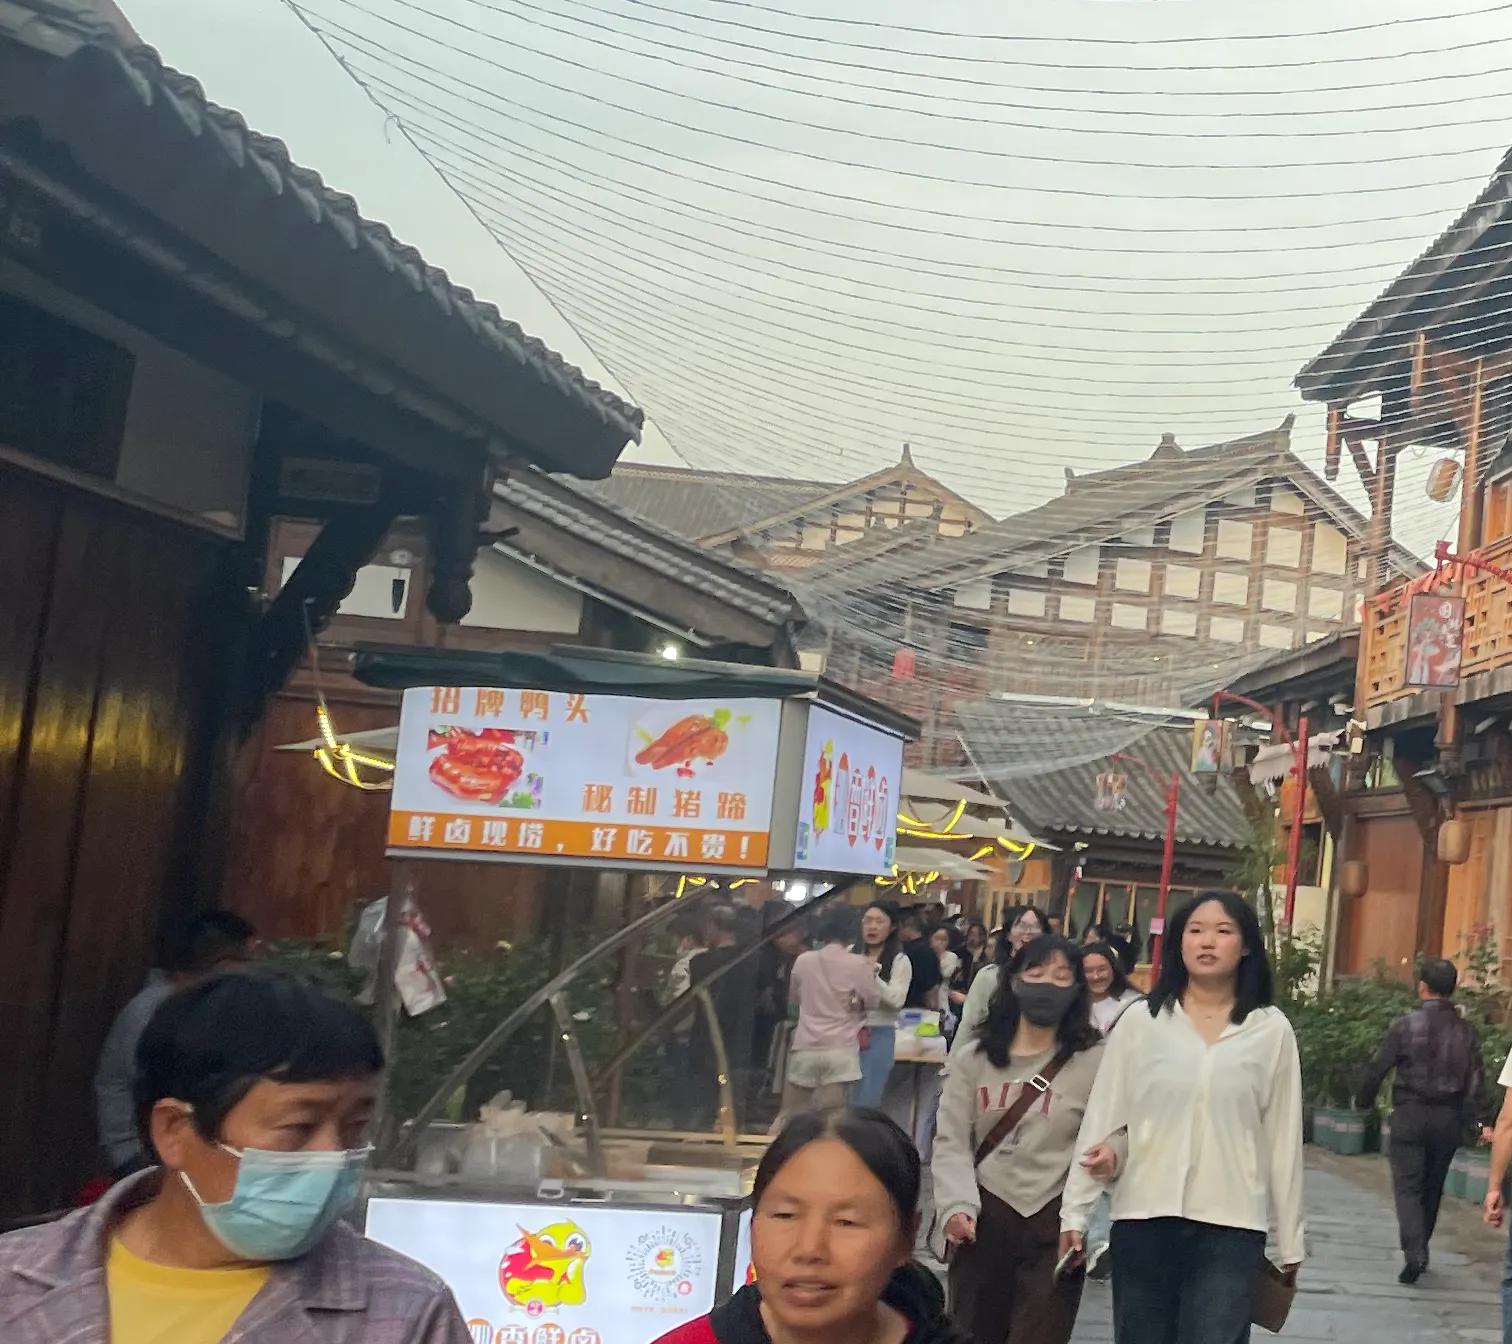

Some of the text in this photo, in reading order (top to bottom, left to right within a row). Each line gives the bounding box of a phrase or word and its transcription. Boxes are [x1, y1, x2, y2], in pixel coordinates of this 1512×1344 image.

[431, 687, 591, 723] 招牌鸭头
[583, 784, 747, 820] 秘制猪蹄
